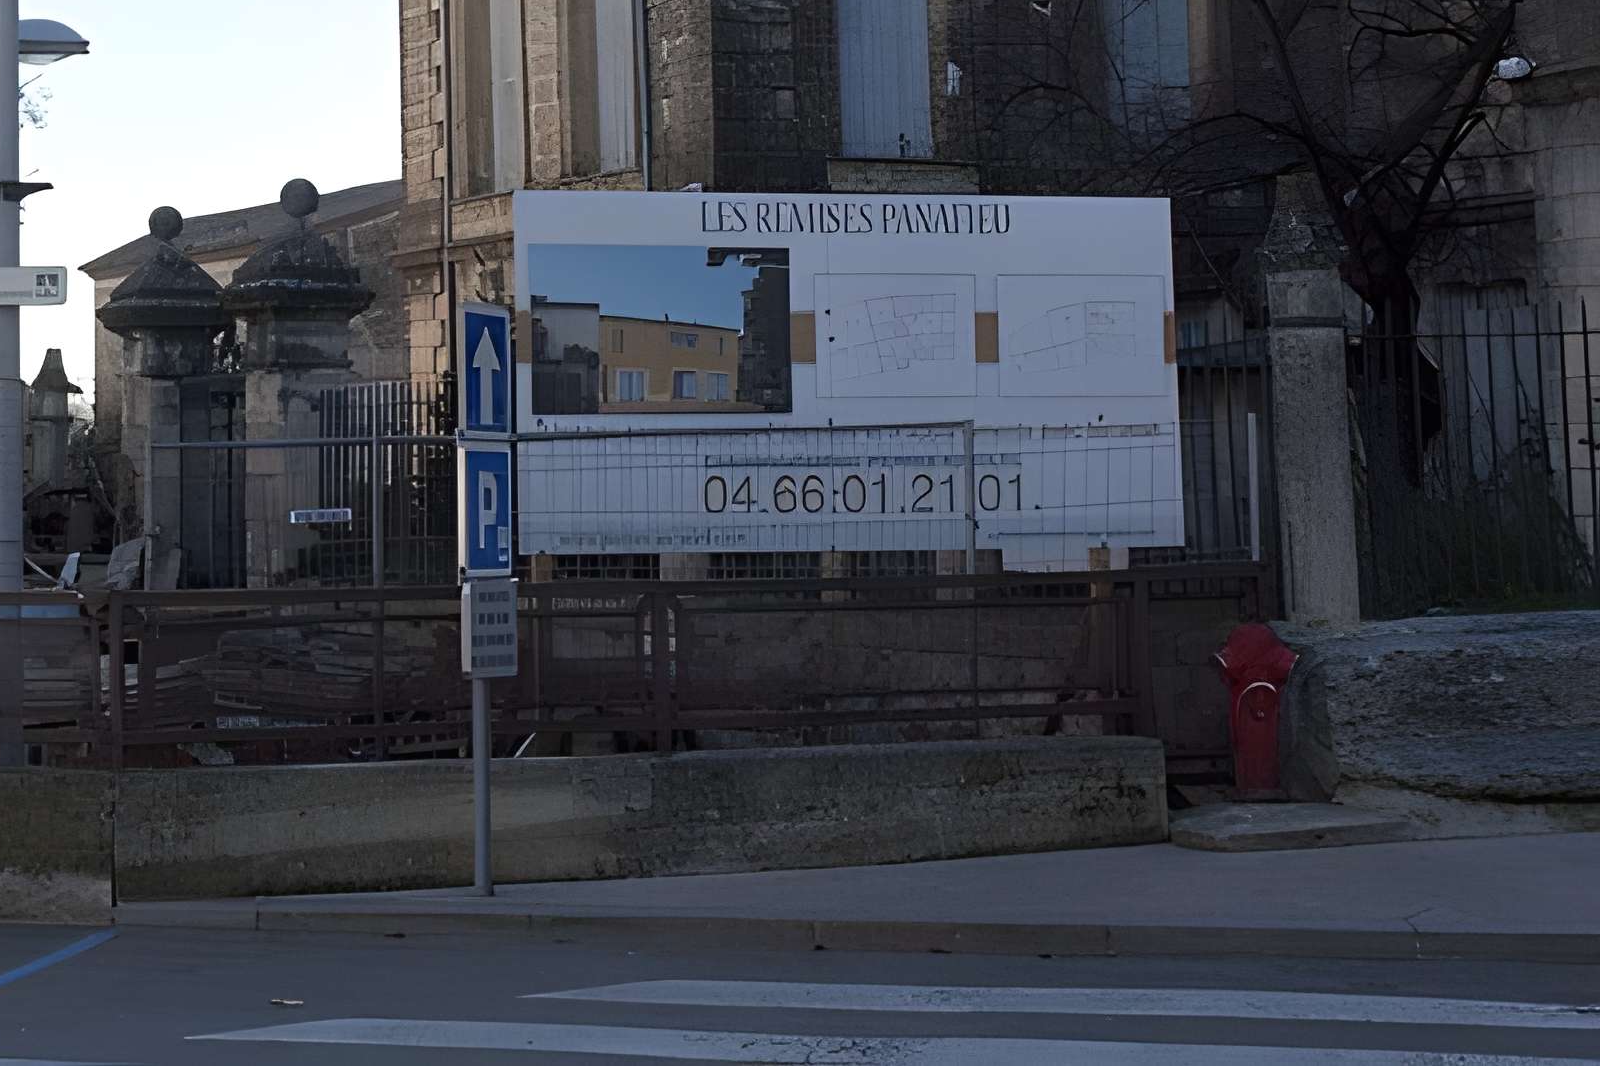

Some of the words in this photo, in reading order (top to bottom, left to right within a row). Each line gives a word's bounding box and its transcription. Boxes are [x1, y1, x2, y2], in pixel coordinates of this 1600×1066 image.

[702, 201, 747, 232] LES
[757, 202, 872, 234] REMISES
[479, 470, 497, 549] P
